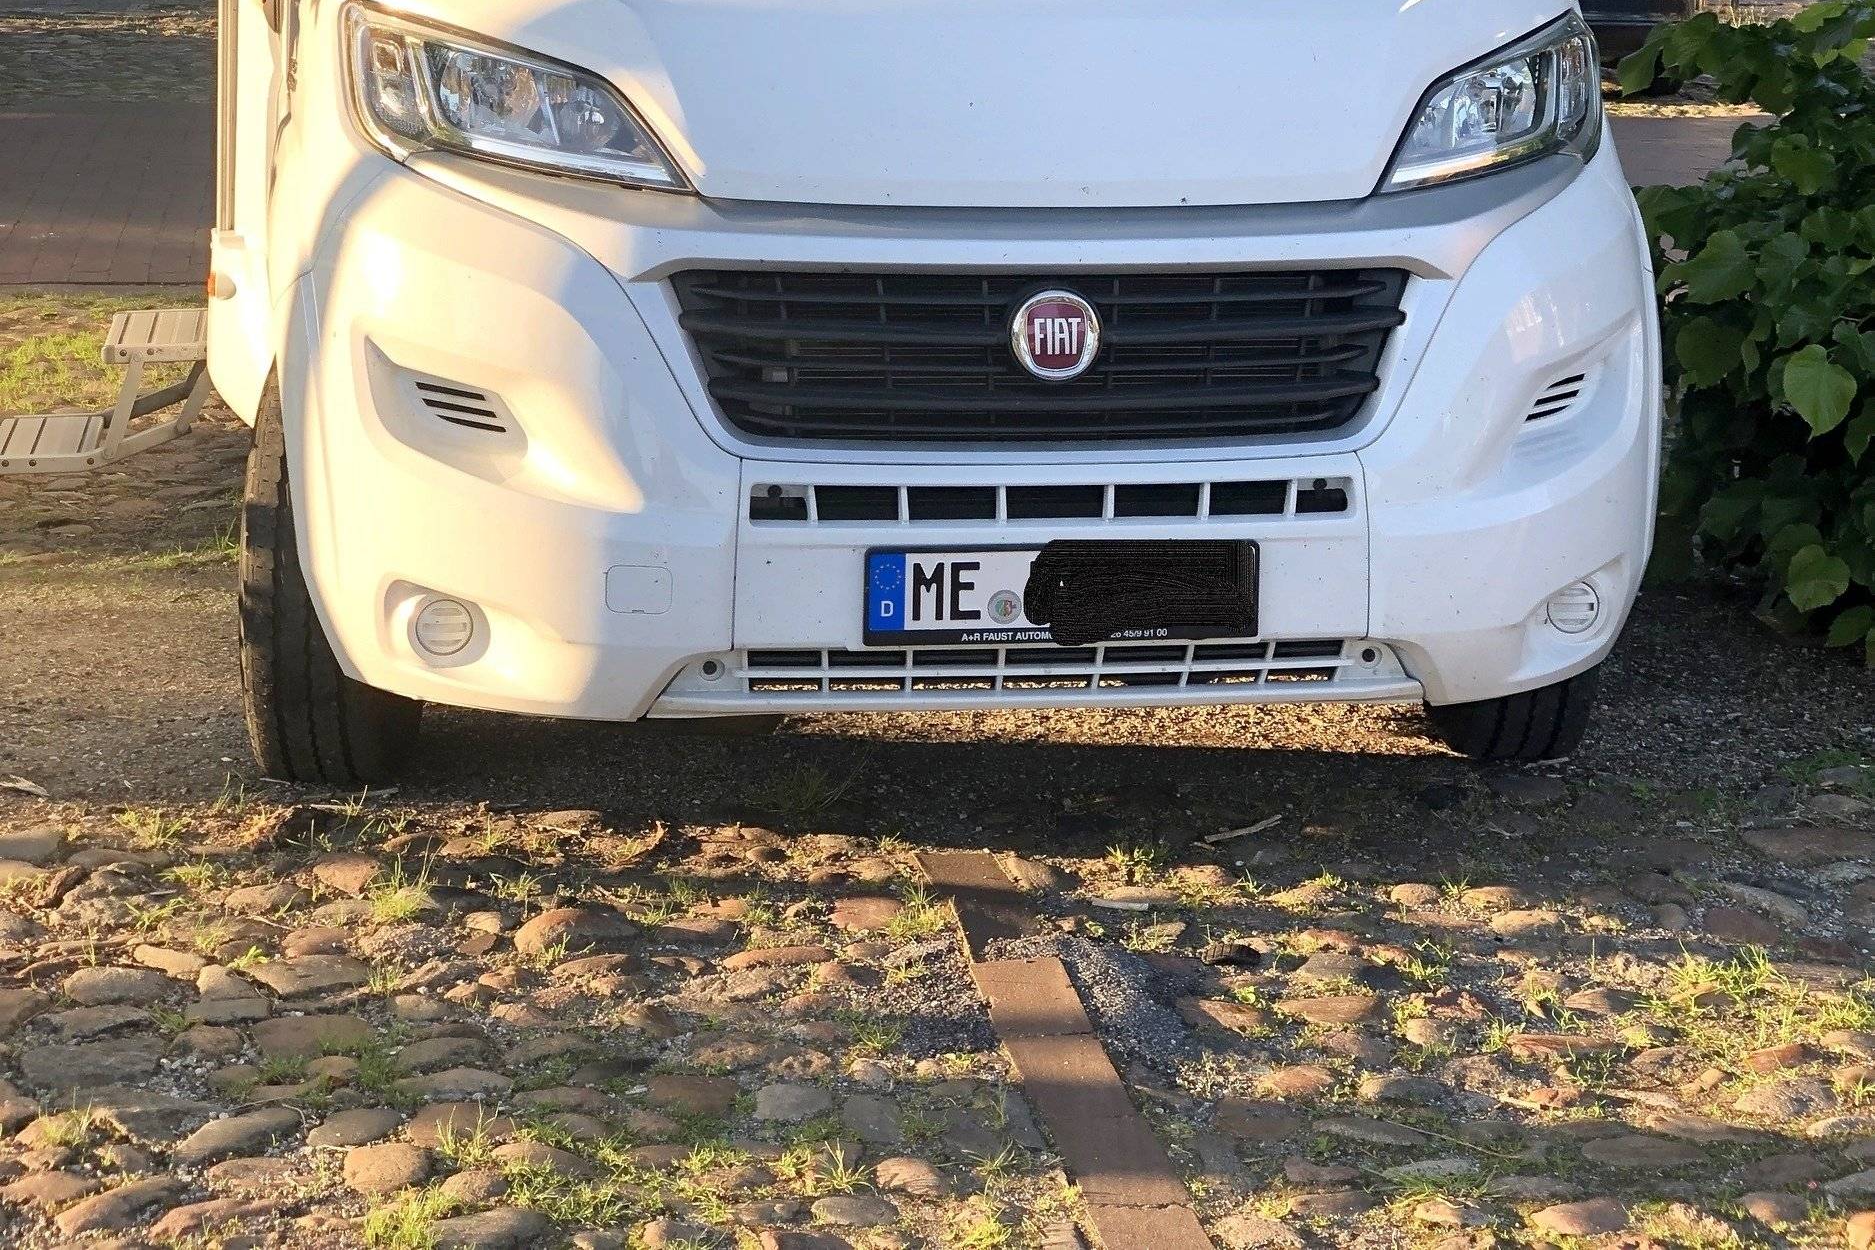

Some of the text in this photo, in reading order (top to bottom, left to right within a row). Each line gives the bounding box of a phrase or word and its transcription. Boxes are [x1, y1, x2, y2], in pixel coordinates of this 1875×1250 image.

[1033, 317, 1082, 355] FIAT
[912, 561, 982, 621] ME
[880, 600, 894, 617] D
[961, 633, 981, 642] A+R
[983, 632, 1014, 641] FAUST
[1156, 628, 1168, 637] 00
